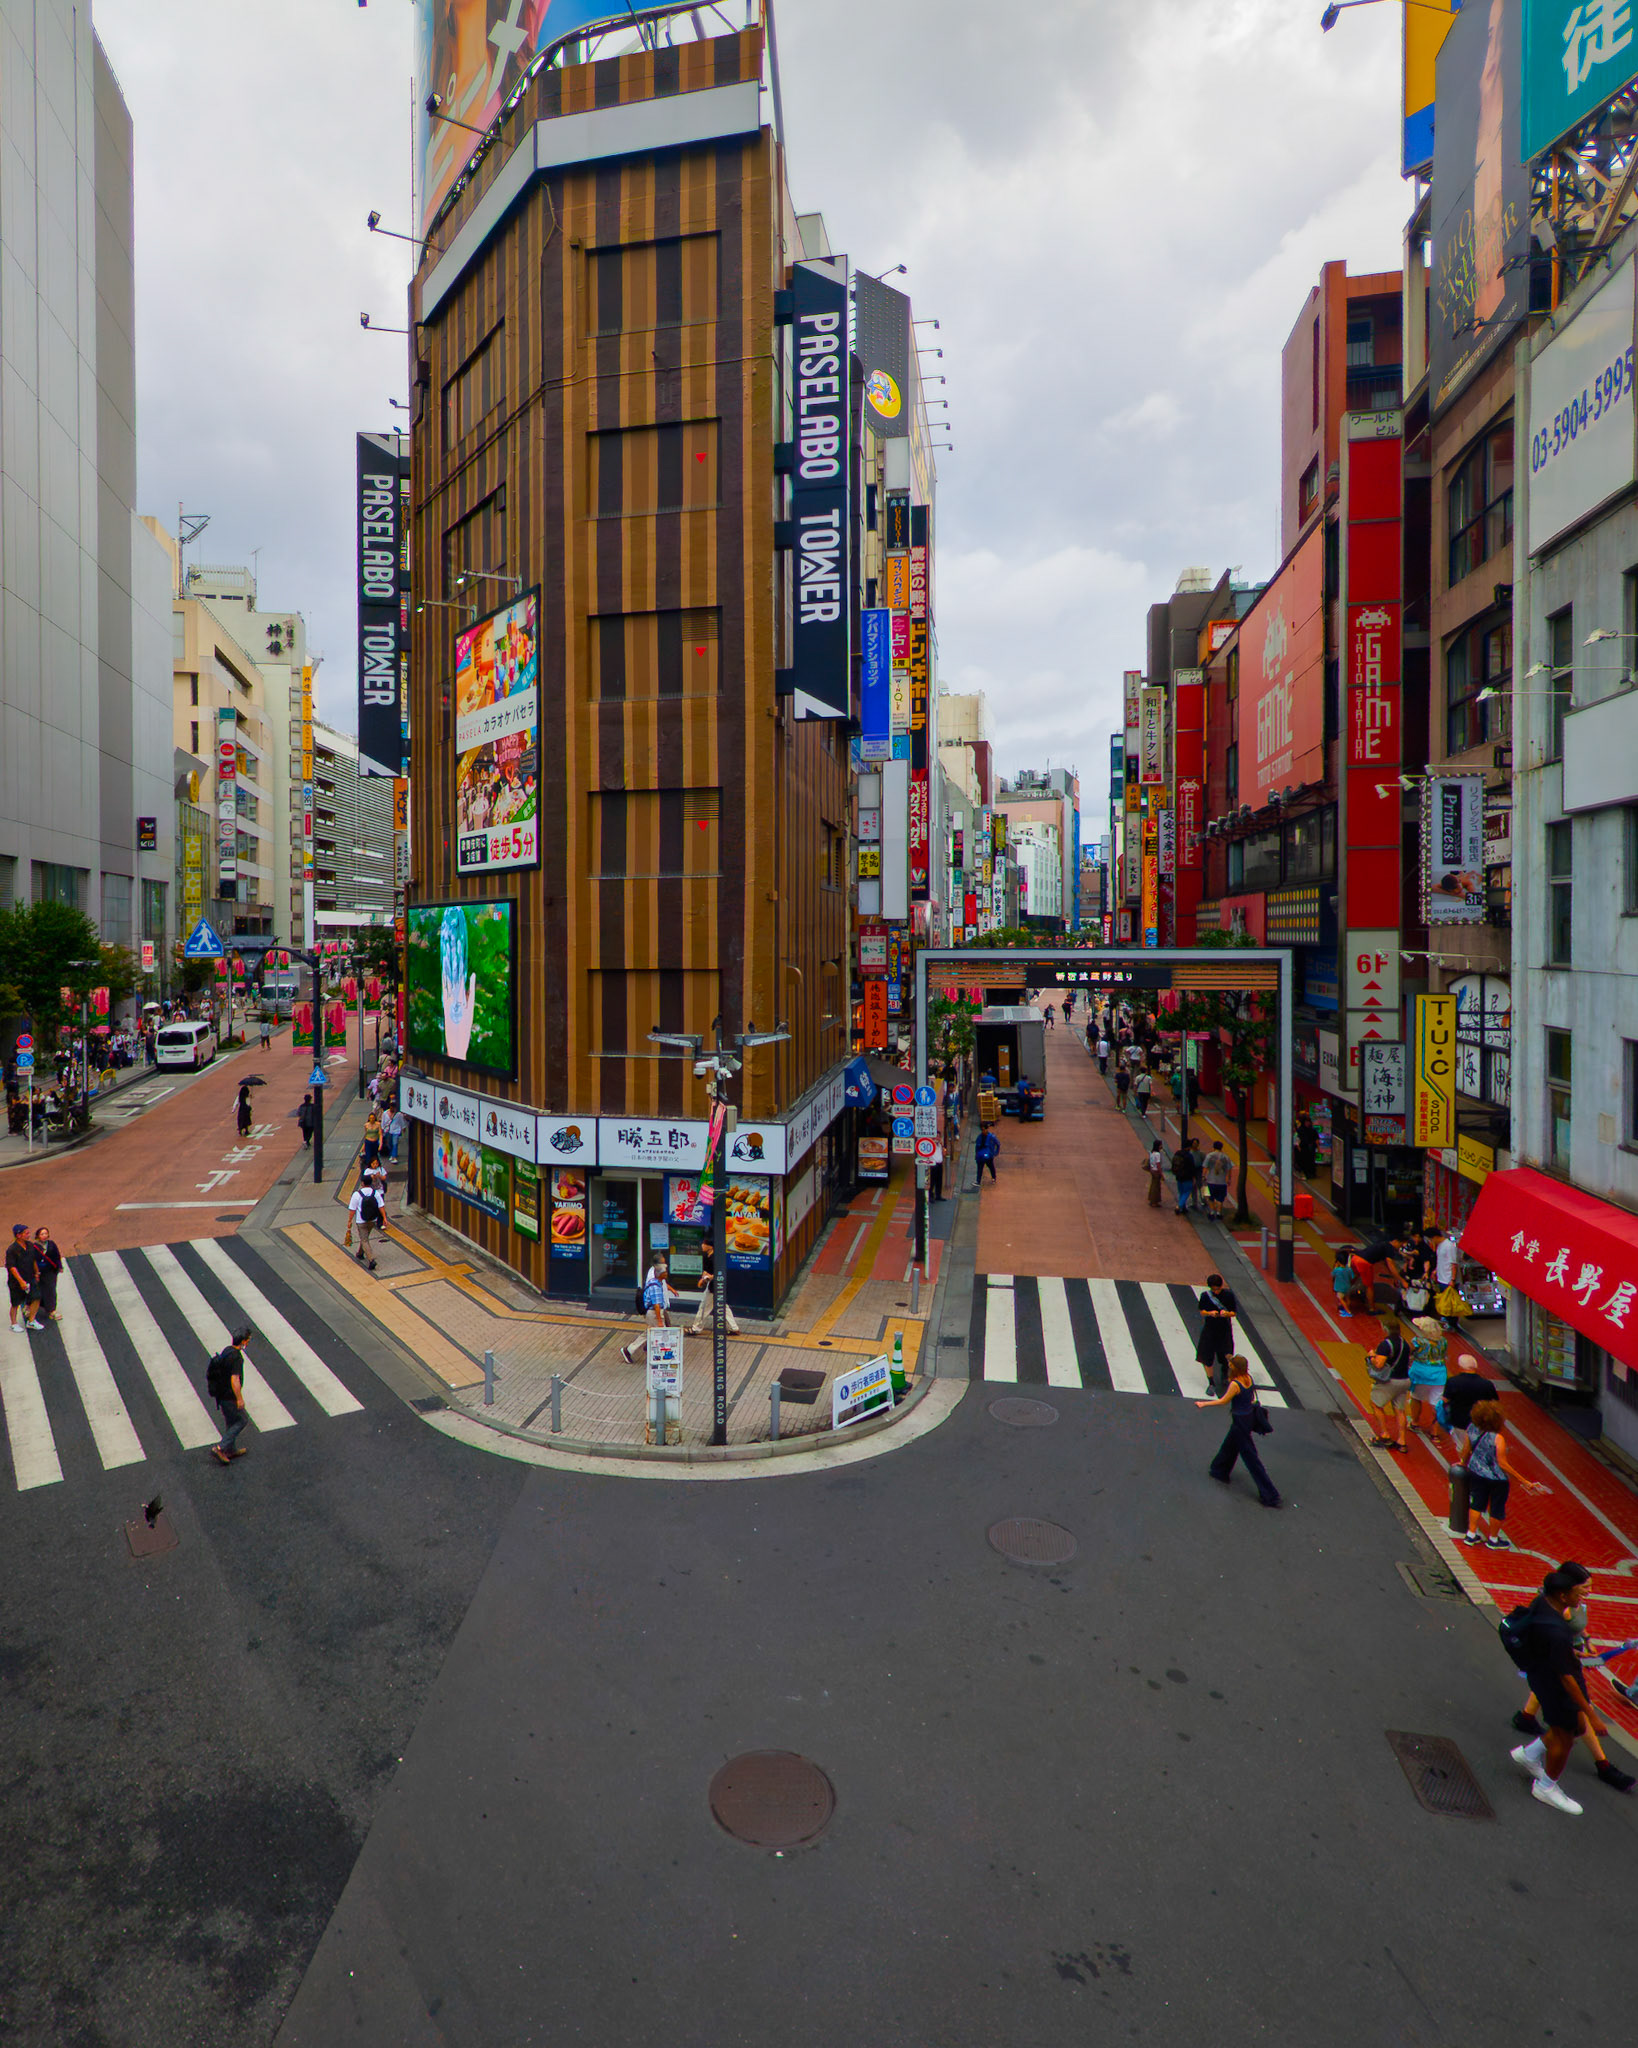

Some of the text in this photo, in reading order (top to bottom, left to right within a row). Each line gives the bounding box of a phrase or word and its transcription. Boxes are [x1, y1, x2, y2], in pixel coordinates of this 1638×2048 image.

[1562, 0, 1633, 96] 徒
[1351, 413, 1395, 425] ワールド
[1532, 345, 1634, 474] 03-5904-5995
[1375, 425, 1399, 437] ビル
[800, 312, 840, 625] PASELABO TOWER
[362, 474, 395, 706] PASELABO TOWER
[866, 613, 880, 688] アパマンショップ
[1355, 633, 1363, 759] TAITO STATION
[1365, 632, 1391, 759] GAME
[483, 701, 535, 733] カラオケパセラ
[1257, 670, 1294, 764] GAME
[909, 781, 921, 849] ベガスベガス
[1469, 786, 1479, 832] リフレッシュ
[1443, 793, 1458, 859] Princess
[489, 828, 534, 861] 徒歩5分
[1055, 971, 1133, 982] 新宿武蔵野通り
[1356, 954, 1388, 974] 6F
[1368, 1046, 1400, 1065] 麺屋
[1373, 1067, 1396, 1111] 海神
[449, 1104, 476, 1127] たい焼き
[499, 1119, 530, 1145] 焼きいも
[1430, 1100, 1440, 1134] SHOP
[617, 1126, 690, 1150] 勝五郎
[920, 1142, 932, 1153] 30
[554, 1200, 584, 1209] YAKIIMO
[730, 1210, 760, 1219] TAIYAKI
[1510, 1230, 1541, 1263] 食堂
[1545, 1248, 1637, 1329] 長野屋
[716, 1275, 725, 1425] SHINJUKU RAMBLING ROAD
[850, 1367, 888, 1394] 歩行者用通路
